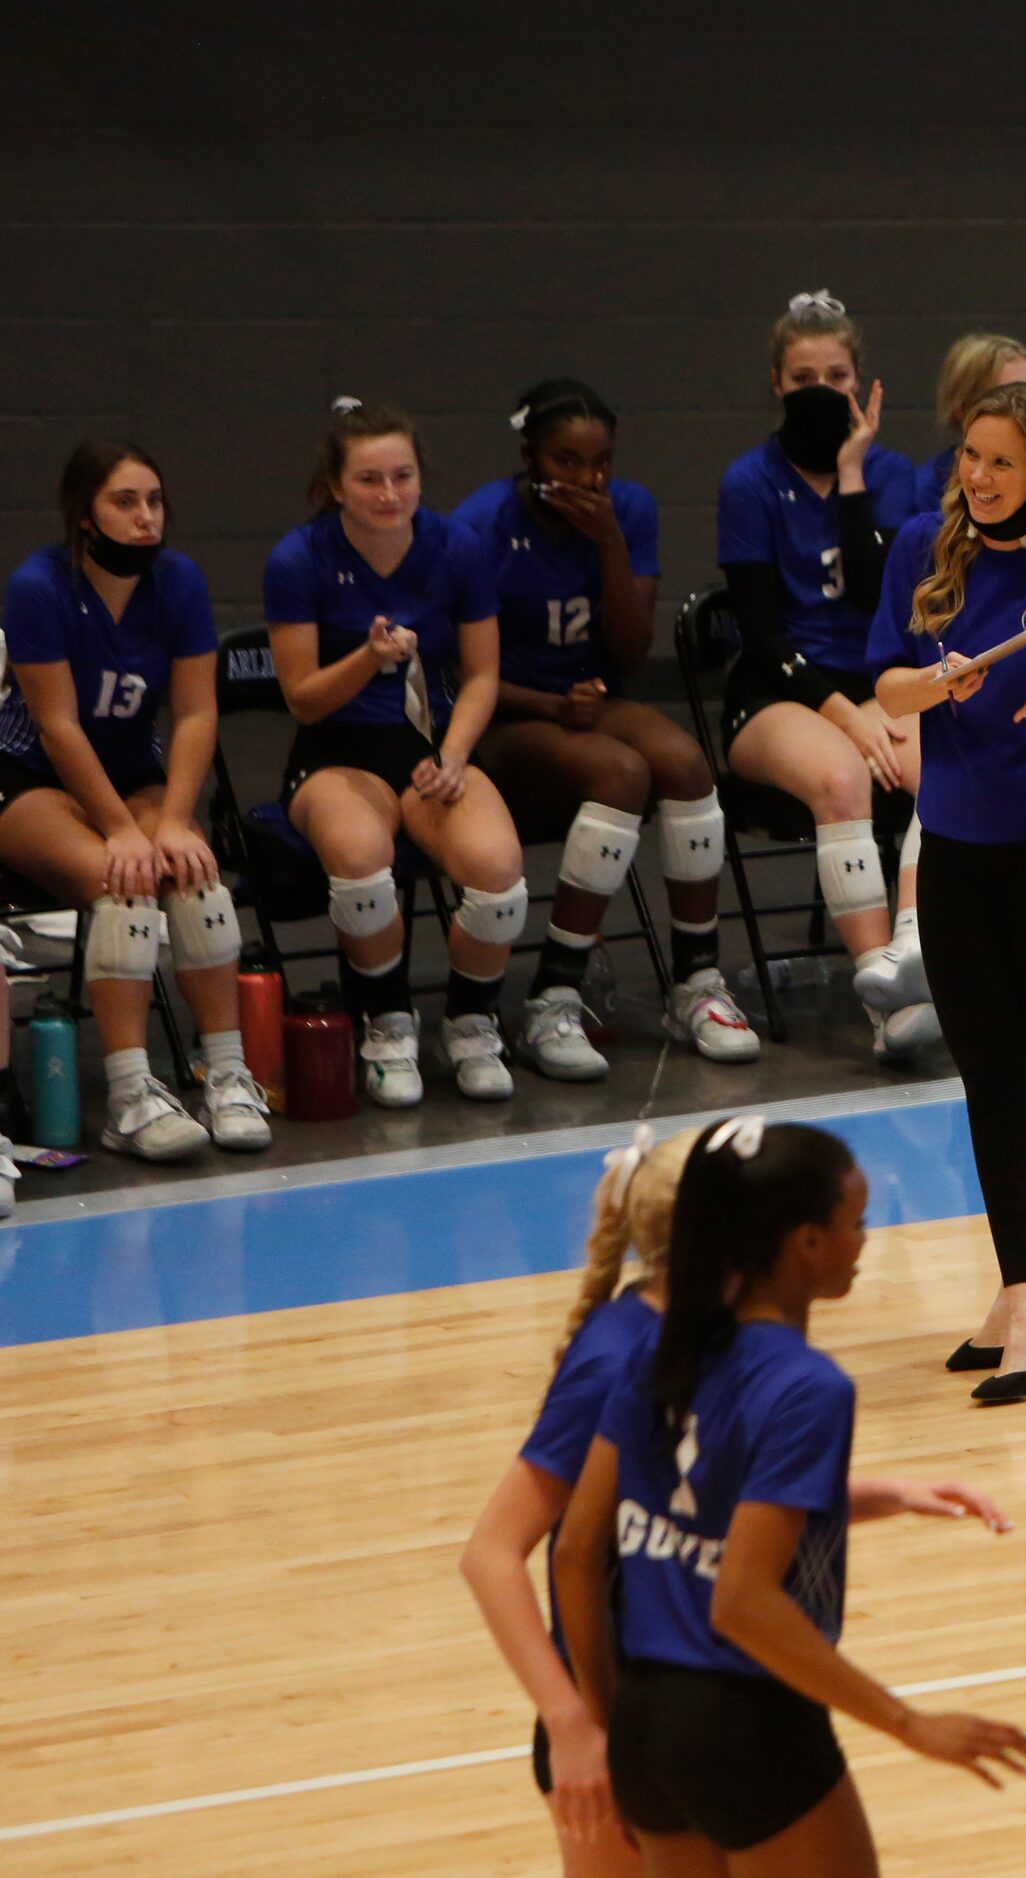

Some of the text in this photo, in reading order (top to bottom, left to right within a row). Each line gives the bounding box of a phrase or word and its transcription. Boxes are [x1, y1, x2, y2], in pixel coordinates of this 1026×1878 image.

[820, 546, 846, 599] 3
[545, 595, 591, 647] 12
[93, 668, 147, 719] 13
